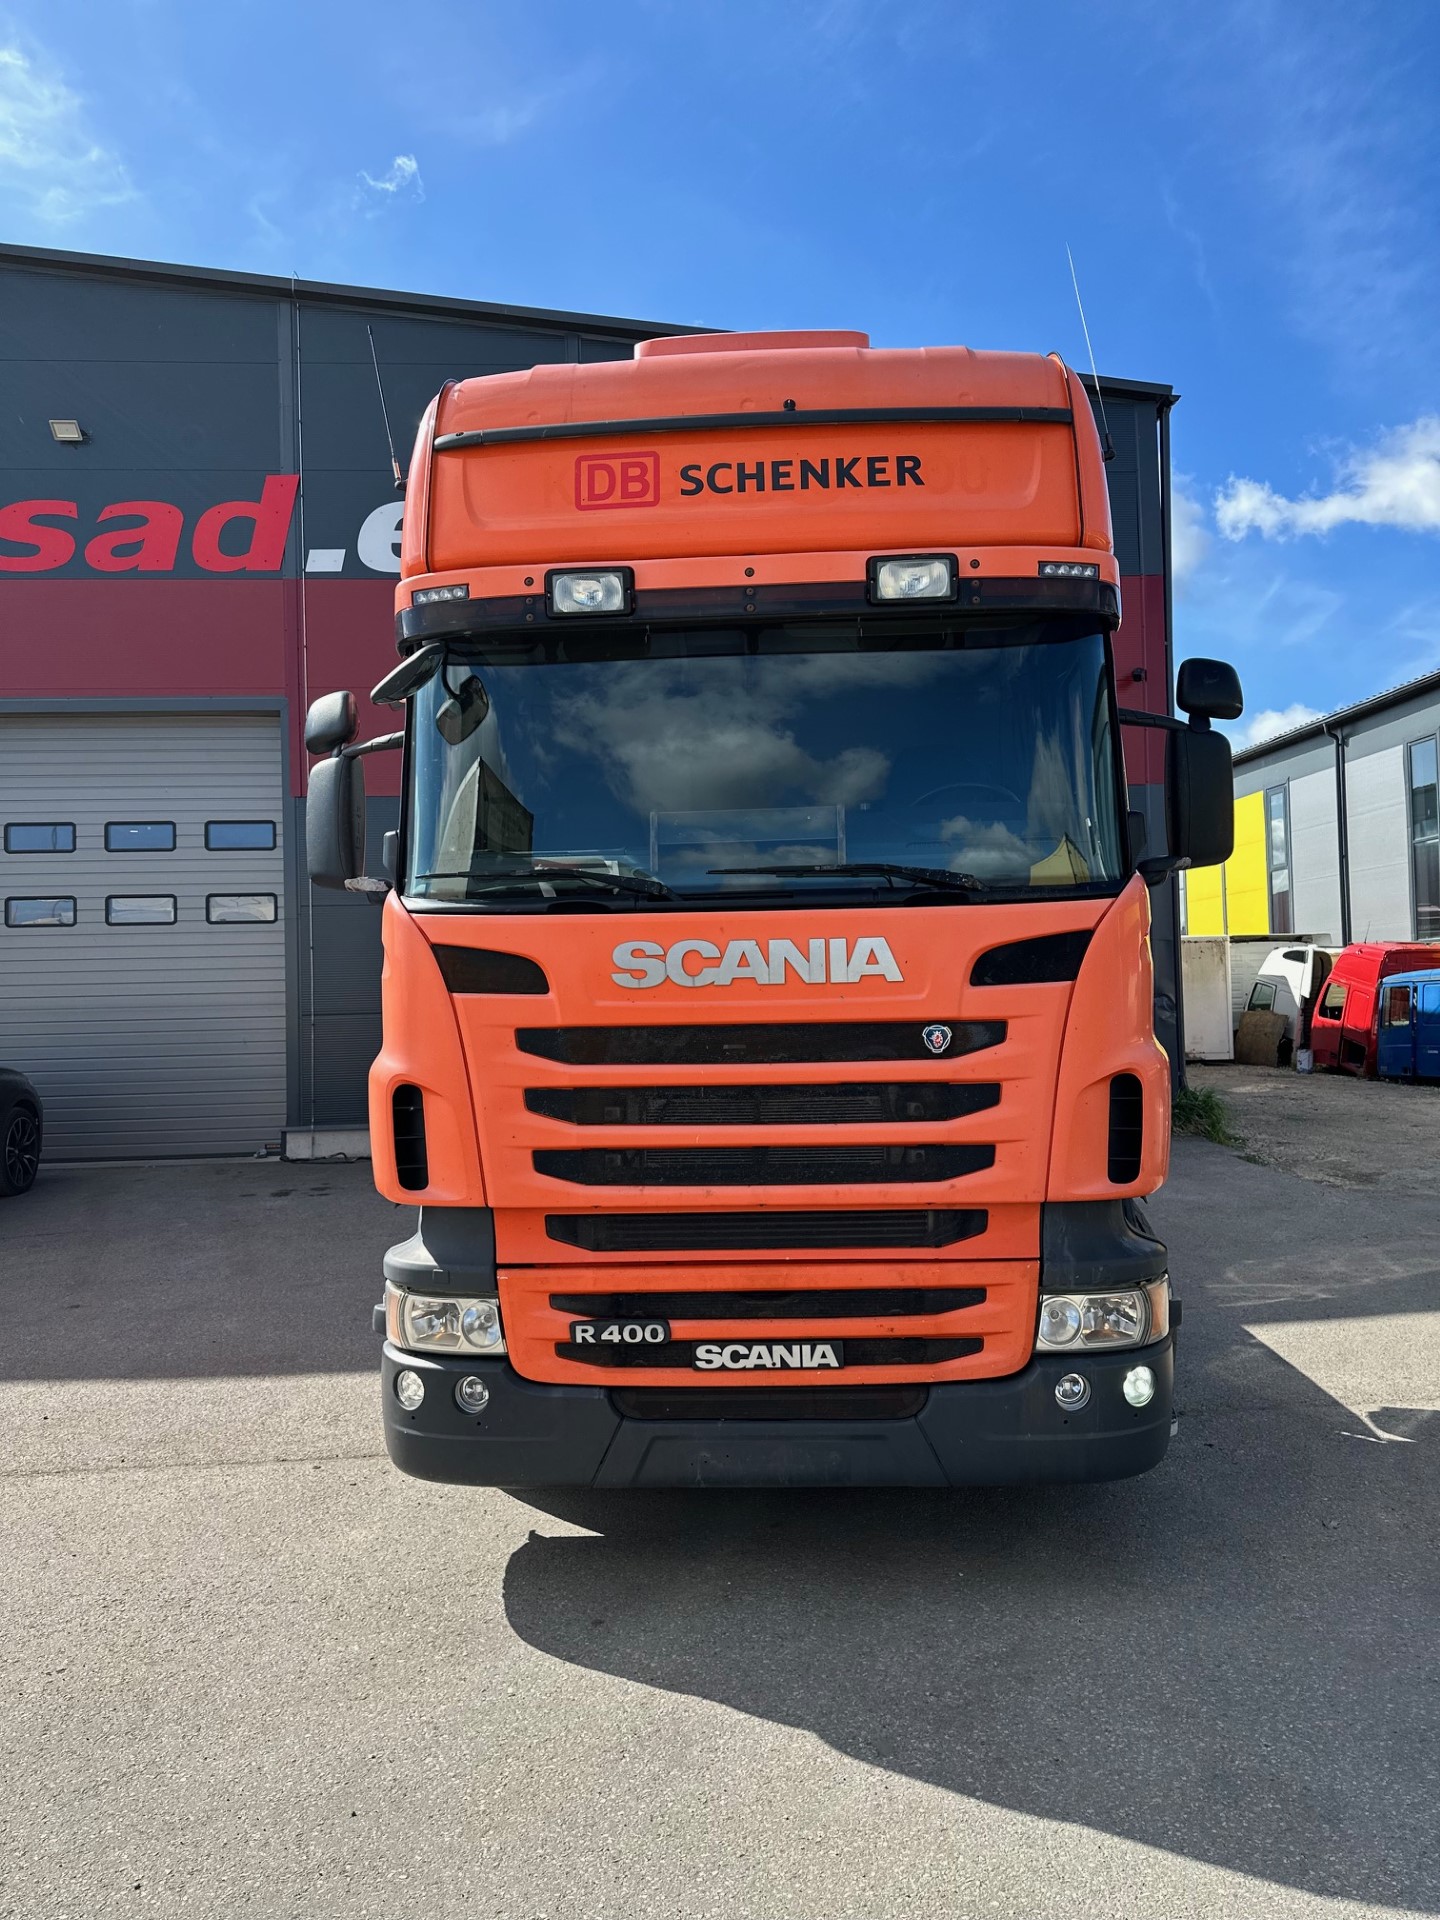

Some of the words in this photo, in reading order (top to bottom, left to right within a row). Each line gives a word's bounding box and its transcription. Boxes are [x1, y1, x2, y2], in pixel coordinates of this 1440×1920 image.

[587, 461, 651, 502] DB
[680, 455, 925, 496] SCHENKER
[611, 936, 904, 988] SCANIA
[575, 1325, 596, 1343] R
[601, 1324, 665, 1343] 400
[695, 1344, 839, 1369] SCANIA
